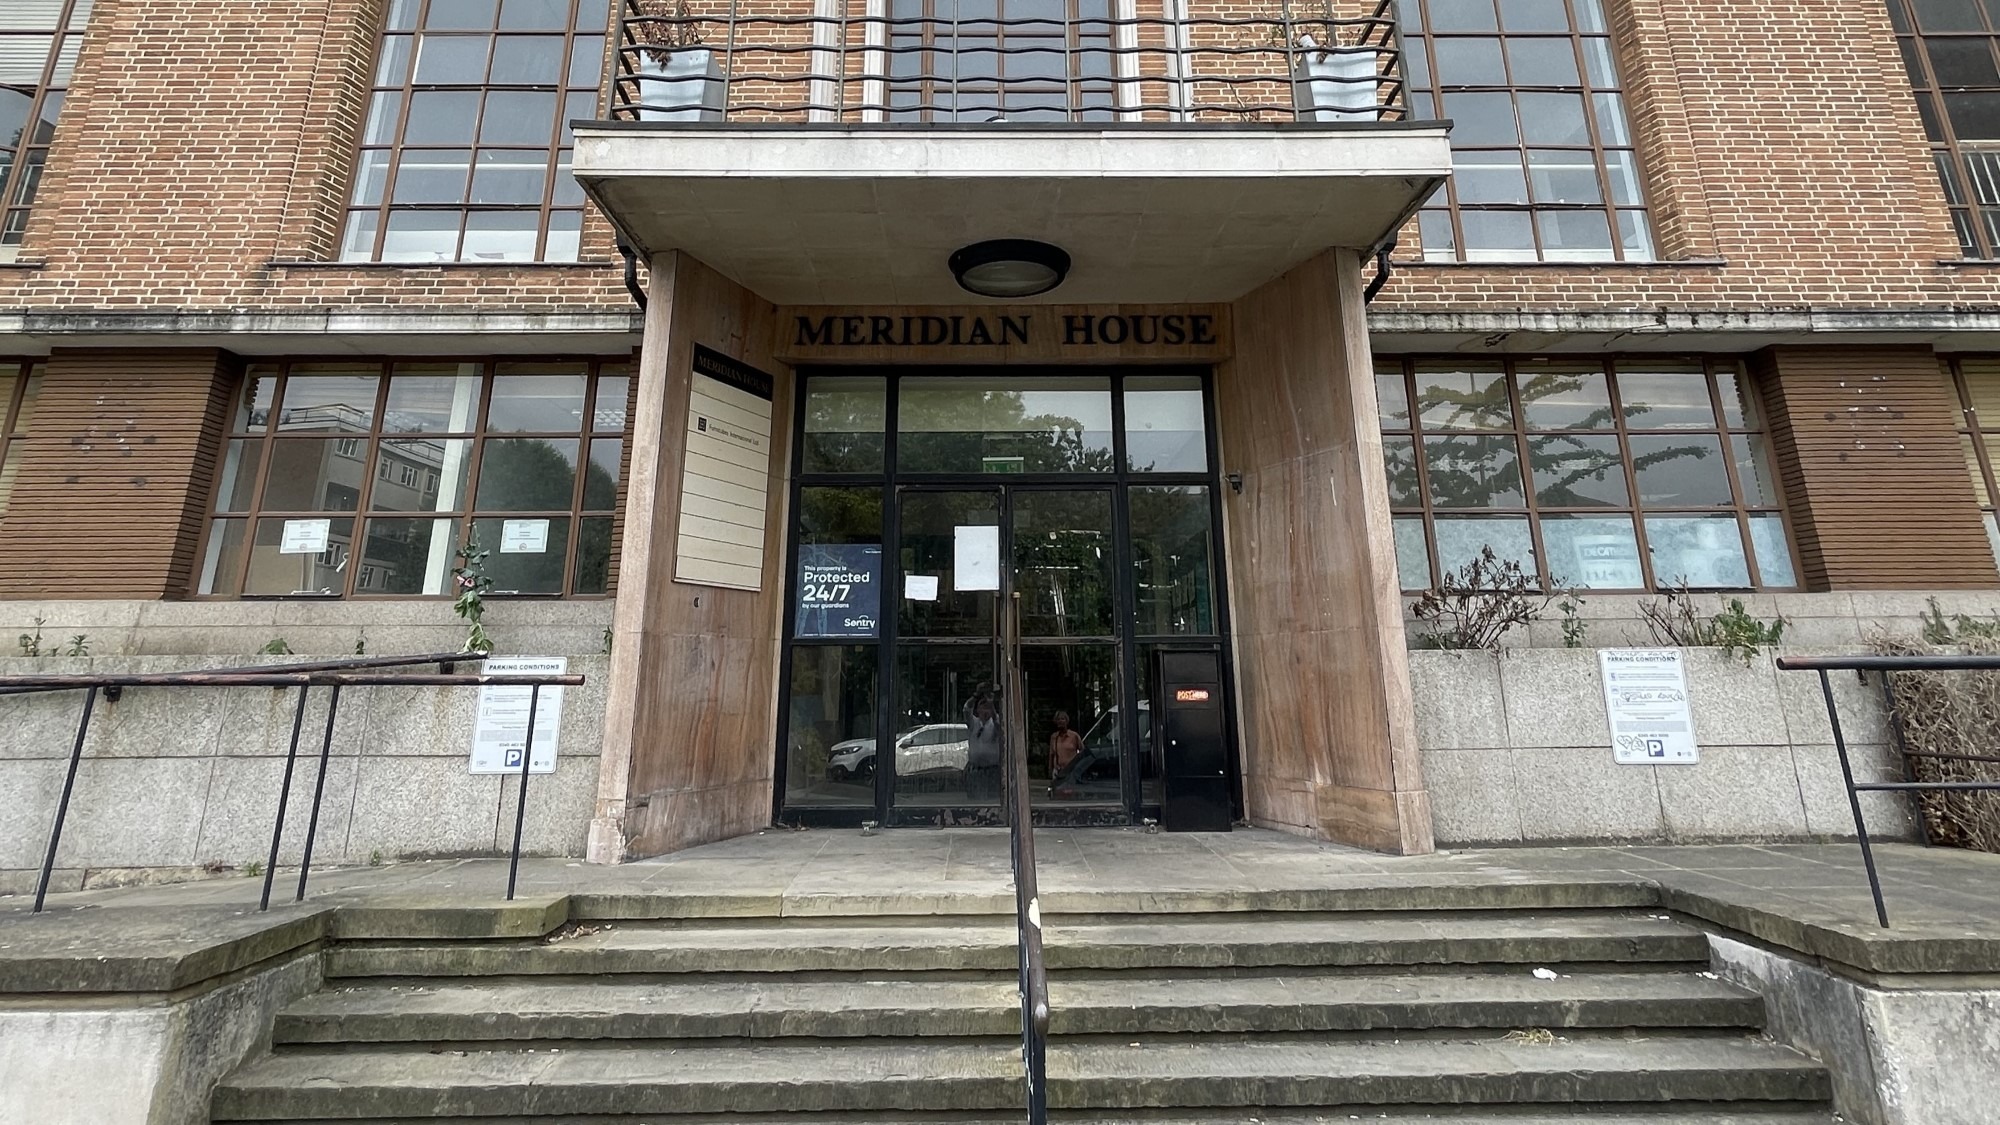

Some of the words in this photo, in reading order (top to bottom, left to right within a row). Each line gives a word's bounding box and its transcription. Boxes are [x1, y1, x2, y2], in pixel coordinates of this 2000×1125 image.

[794, 315, 1032, 346] MERIDIAN
[1064, 314, 1217, 346] HOUSE
[698, 355, 742, 381] MERIDIAN
[743, 374, 769, 393] HOUSE
[803, 571, 870, 583] Protected
[802, 584, 851, 602] 24/7
[821, 602, 850, 610] guardians
[844, 617, 876, 628] Sentry
[1648, 740, 1664, 757] P
[505, 750, 521, 767] P
